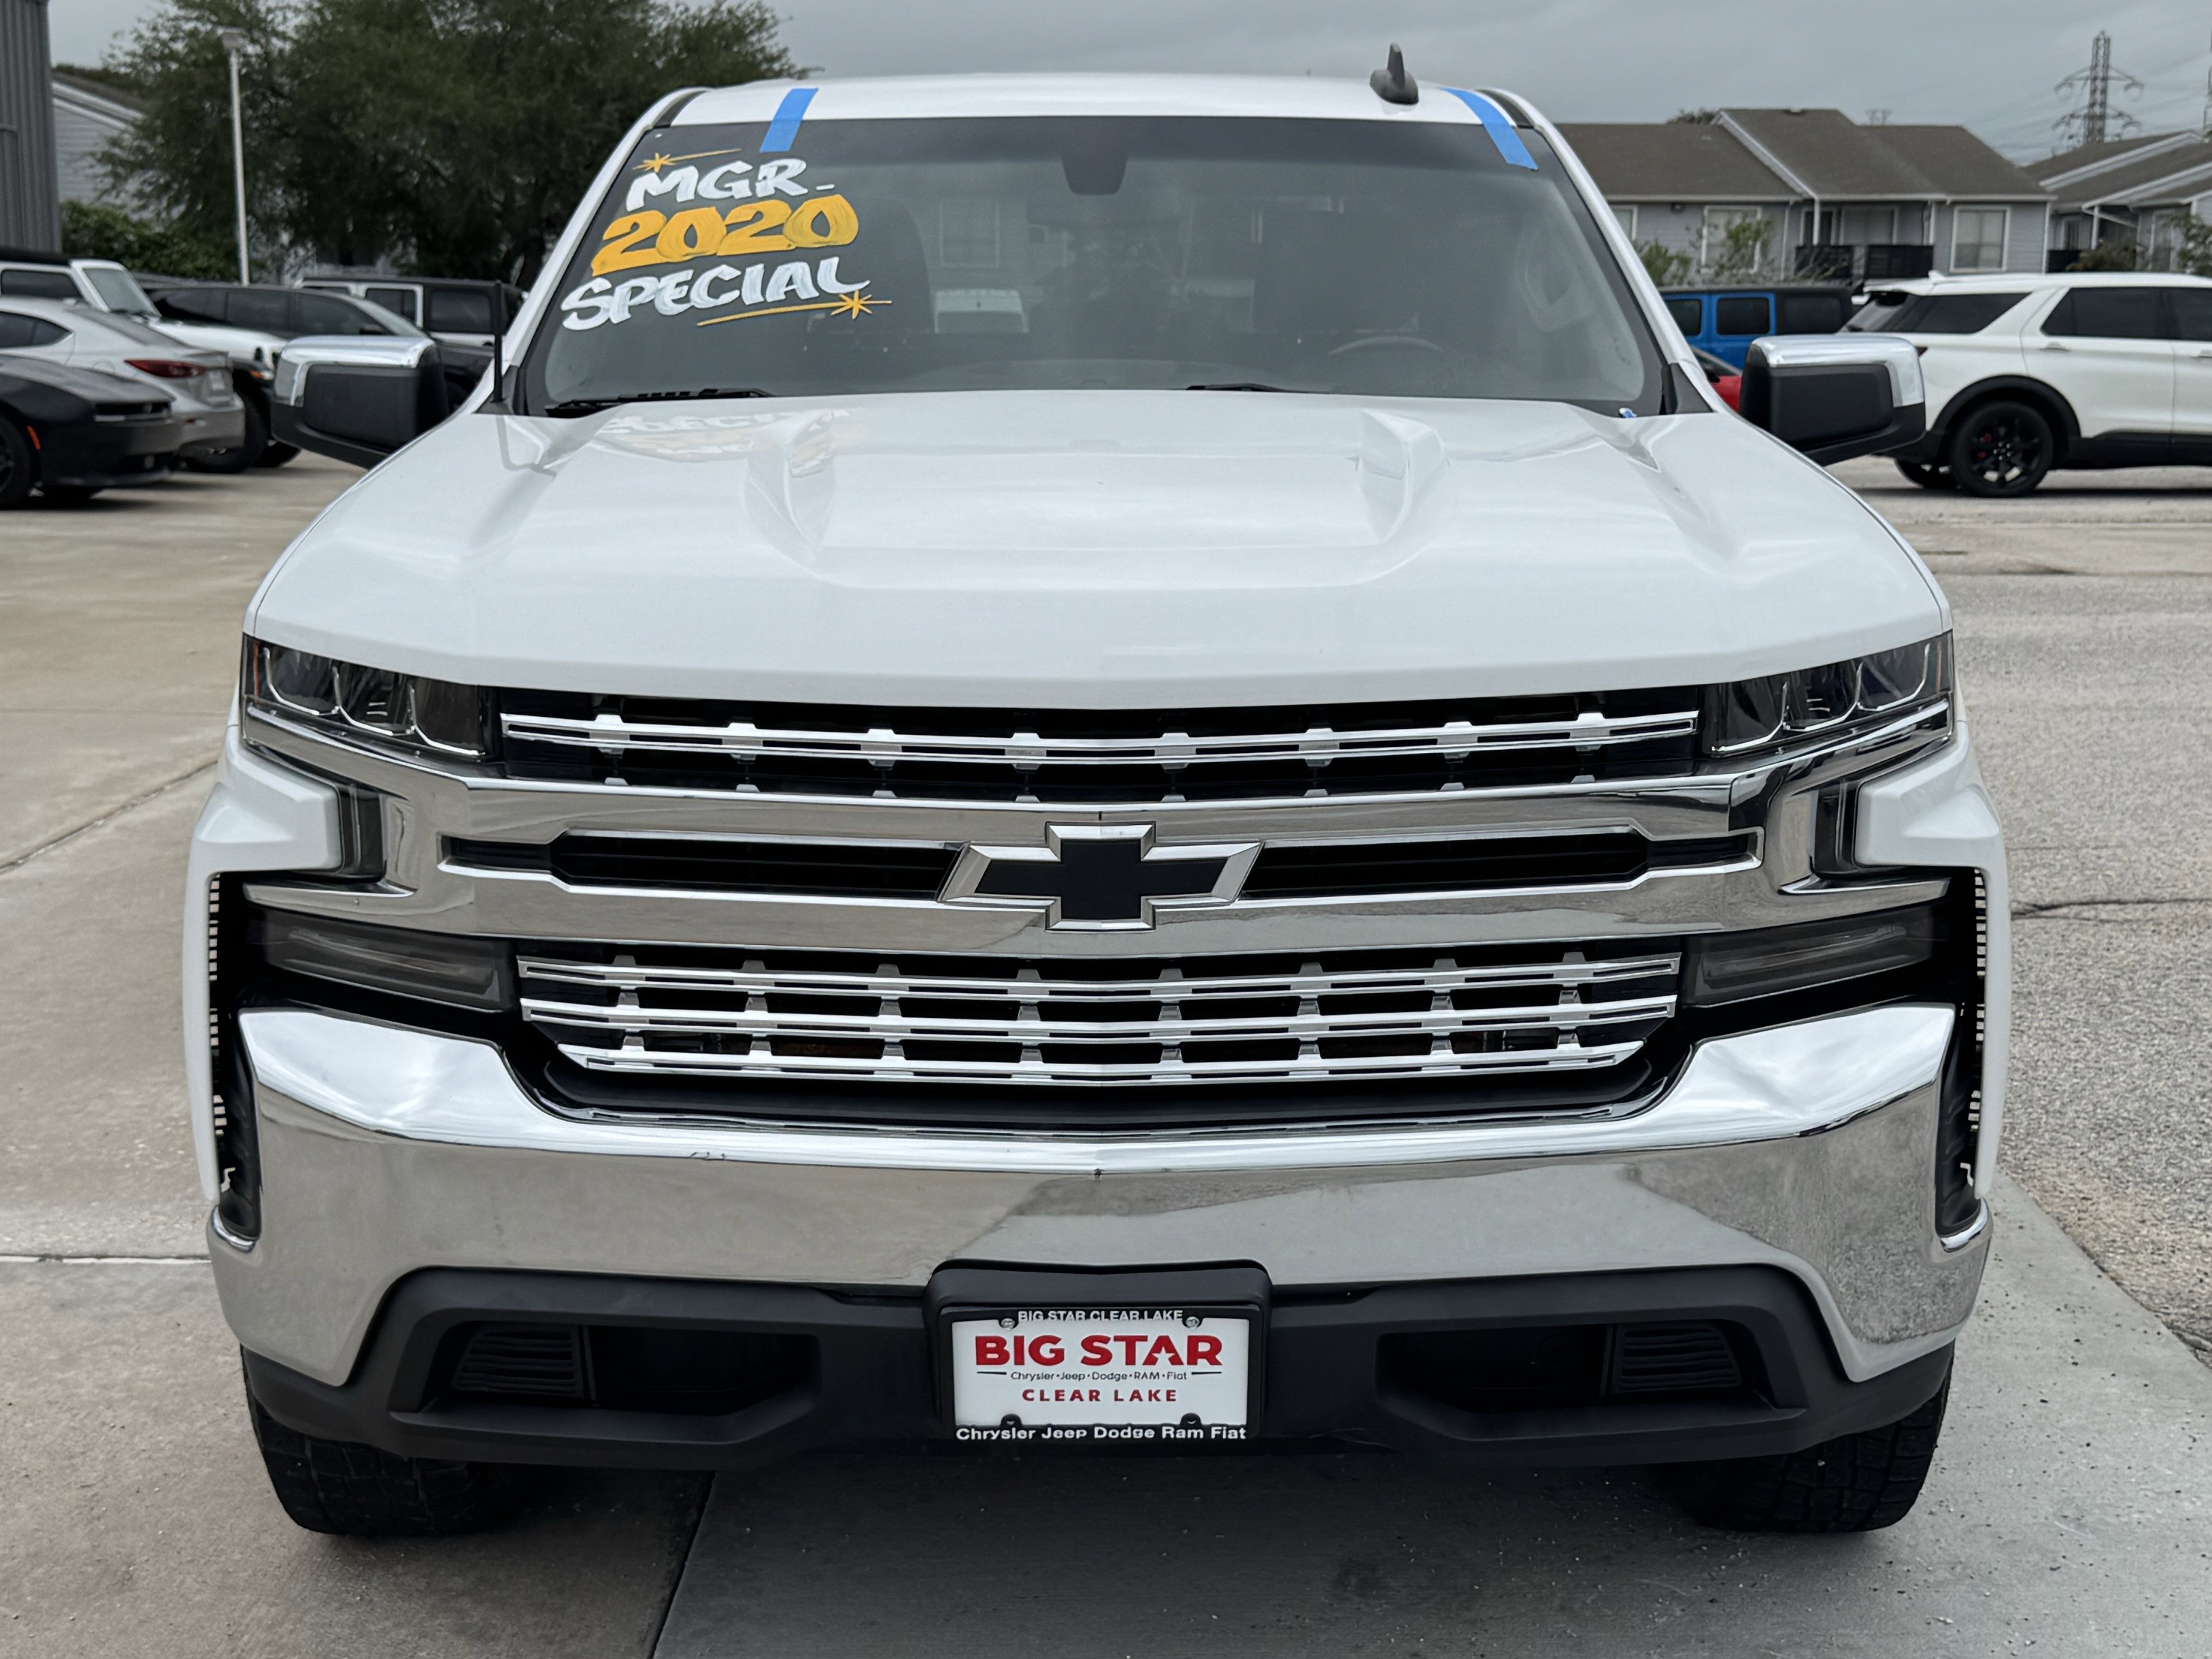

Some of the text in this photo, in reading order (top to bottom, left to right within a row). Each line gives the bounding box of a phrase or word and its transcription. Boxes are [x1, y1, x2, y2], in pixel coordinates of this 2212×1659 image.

[591, 194, 859, 276] 2020
[561, 256, 871, 331] SPECIAL
[1018, 1310, 1183, 1321] BIG STAR CLEAR LAKE
[975, 1335, 1223, 1366] BIG STAR
[1134, 1372, 1160, 1380] RAM
[1022, 1389, 1176, 1402] CLEAR LAKE
[956, 1426, 1247, 1440] Chrysler Jeep Dodge Ram Fiat
